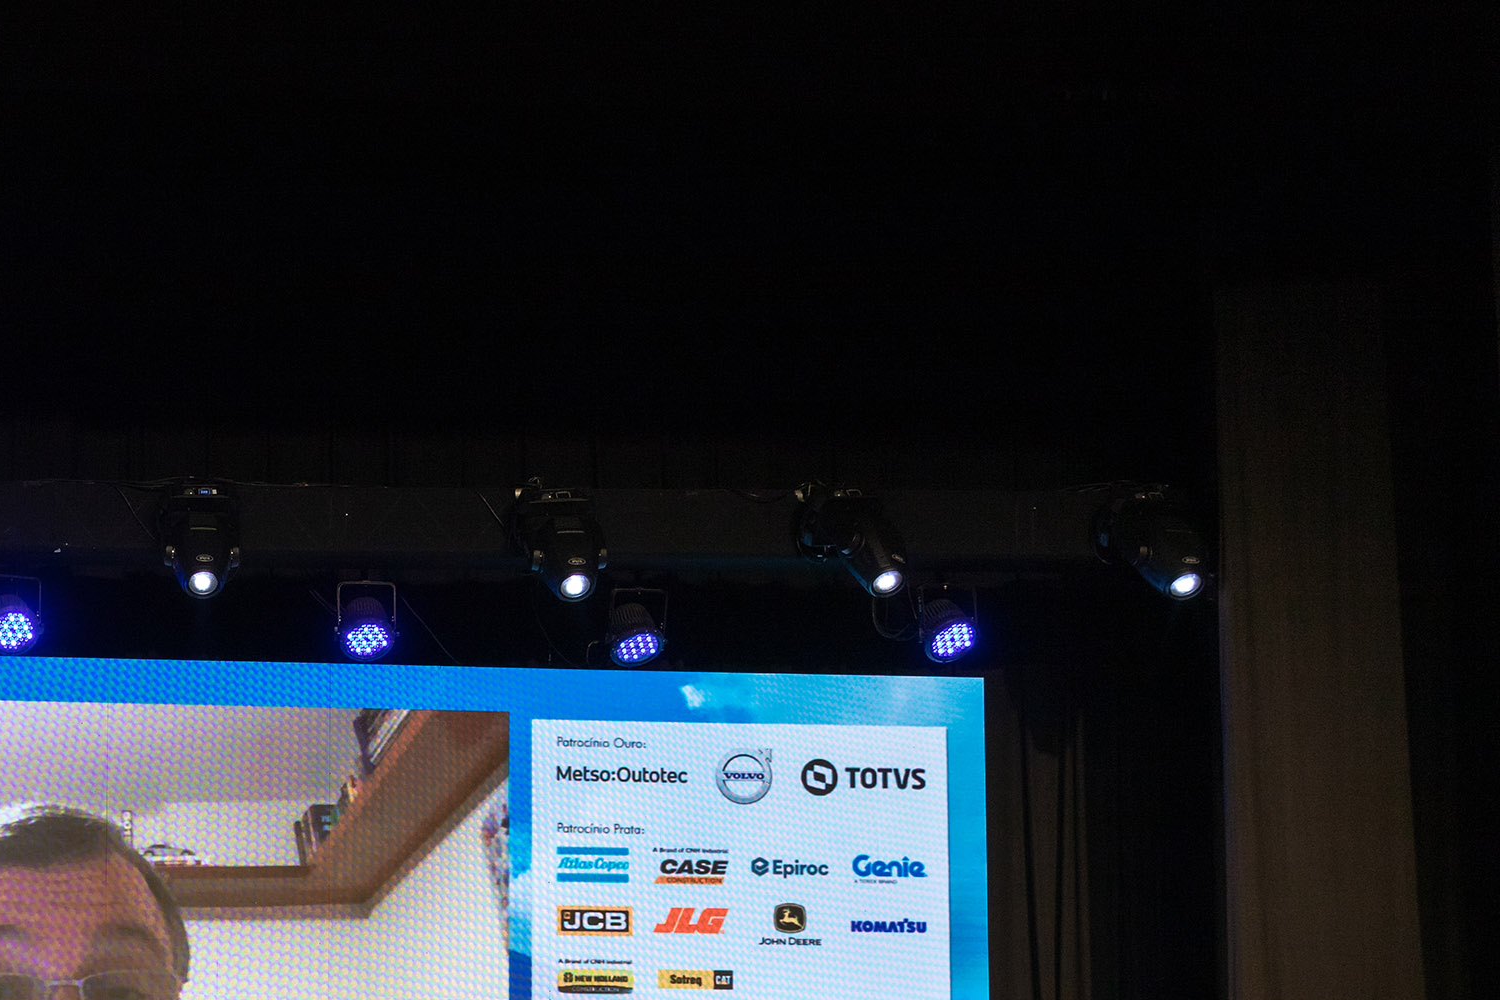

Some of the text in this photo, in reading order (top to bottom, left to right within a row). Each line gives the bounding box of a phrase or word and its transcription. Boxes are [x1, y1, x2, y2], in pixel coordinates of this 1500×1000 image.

[557, 736, 647, 749] Patrocínio Ouro:
[556, 765, 688, 784] Metso:Outotec
[723, 772, 765, 780] VOLVO
[845, 767, 926, 790] TOTVS
[557, 822, 645, 835] Patrocínio Prata:
[660, 859, 729, 875] CASE
[773, 860, 829, 878] Epiroc
[852, 854, 929, 877] Genie
[563, 911, 628, 930] JCB
[653, 907, 729, 934] JLG
[851, 918, 927, 933] KOMATSU
[574, 975, 629, 983] NEW HOLLAND
[670, 974, 702, 986] Sotreq
[715, 975, 731, 985] CAT
